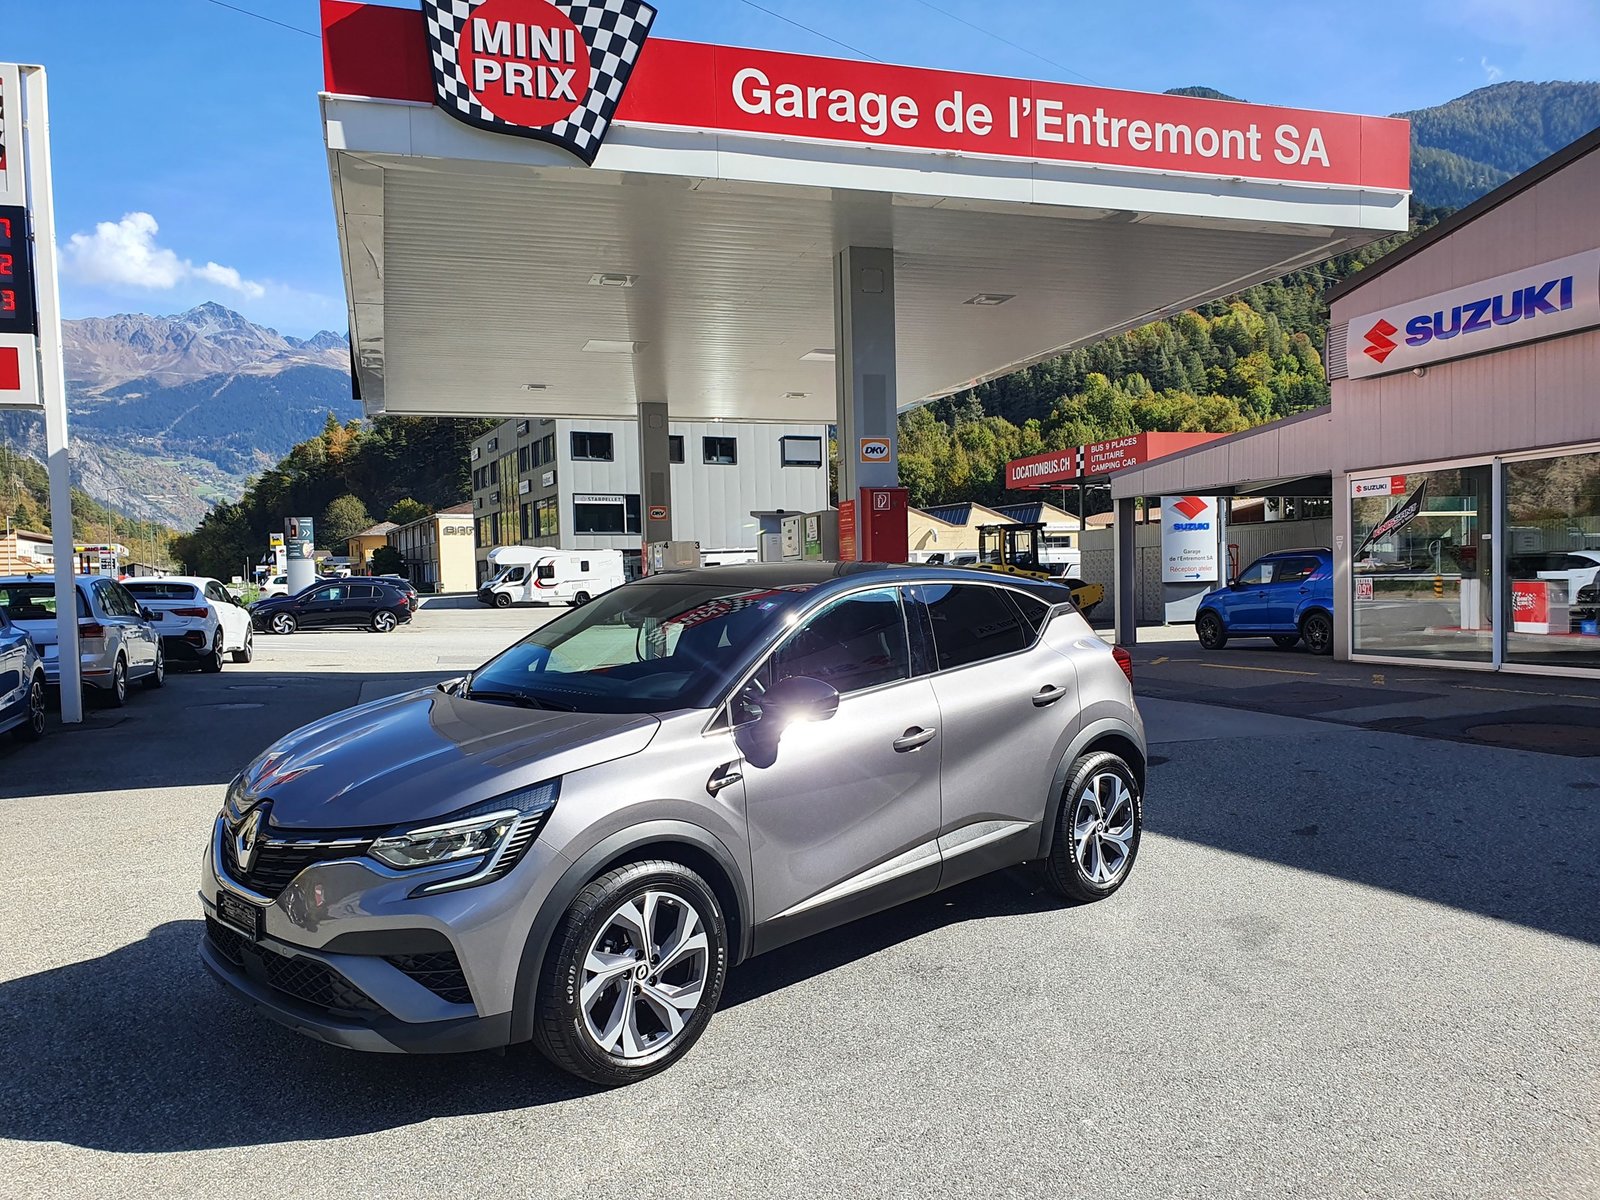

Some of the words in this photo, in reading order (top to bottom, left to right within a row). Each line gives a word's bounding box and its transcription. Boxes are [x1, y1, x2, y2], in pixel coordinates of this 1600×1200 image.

[473, 17, 576, 64] MINI
[473, 58, 578, 102] PRIX
[731, 67, 919, 137] Garage
[934, 90, 993, 136] de
[1009, 96, 1262, 162] l'Entremont
[1274, 124, 1330, 167] SA
[1405, 276, 1574, 347] SUZUKI
[865, 447, 886, 455] DKV
[1091, 445, 1104, 453] BUS
[1111, 437, 1137, 449] PLACES
[1091, 450, 1124, 463] UTILITAIRE
[1012, 457, 1070, 480] LOCATIONBUS.CH
[1091, 461, 1121, 472] CAMPING
[1122, 457, 1137, 467] CAR
[1173, 522, 1210, 531] SUZUKI
[663, 541, 669, 549] 4
[694, 541, 700, 549] 3
